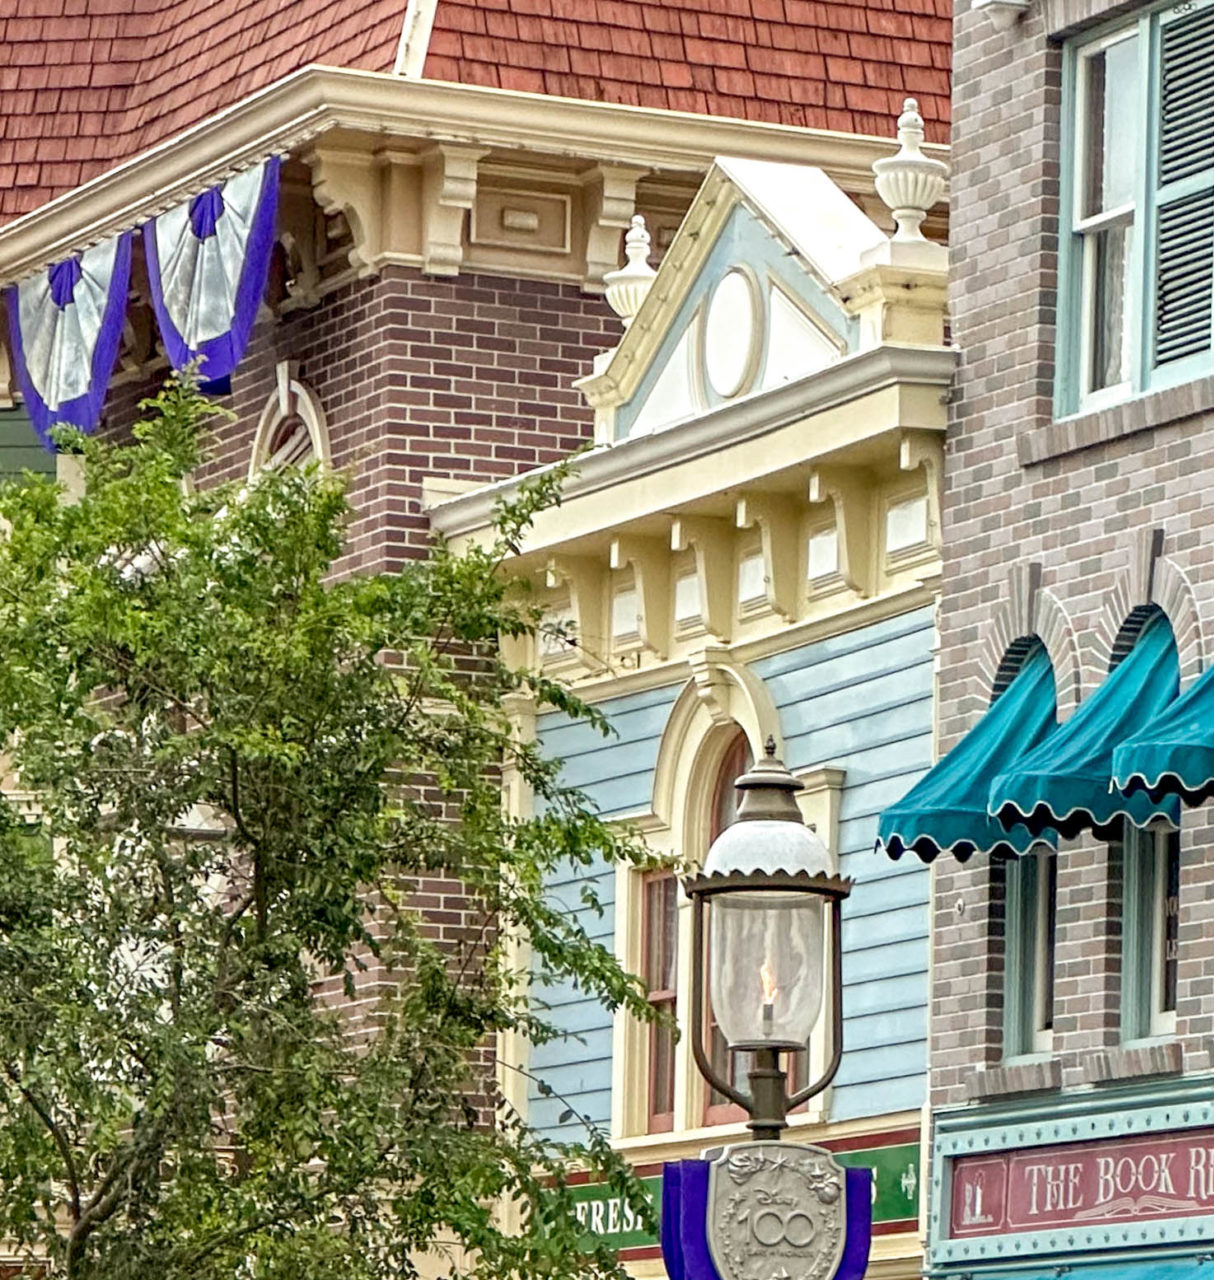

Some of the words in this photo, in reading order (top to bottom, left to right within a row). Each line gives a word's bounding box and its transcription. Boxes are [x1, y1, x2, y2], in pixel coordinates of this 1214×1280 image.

[1025, 1162, 1083, 1215] THE
[1094, 1153, 1176, 1206] BOOK
[738, 1209, 816, 1248] 100
